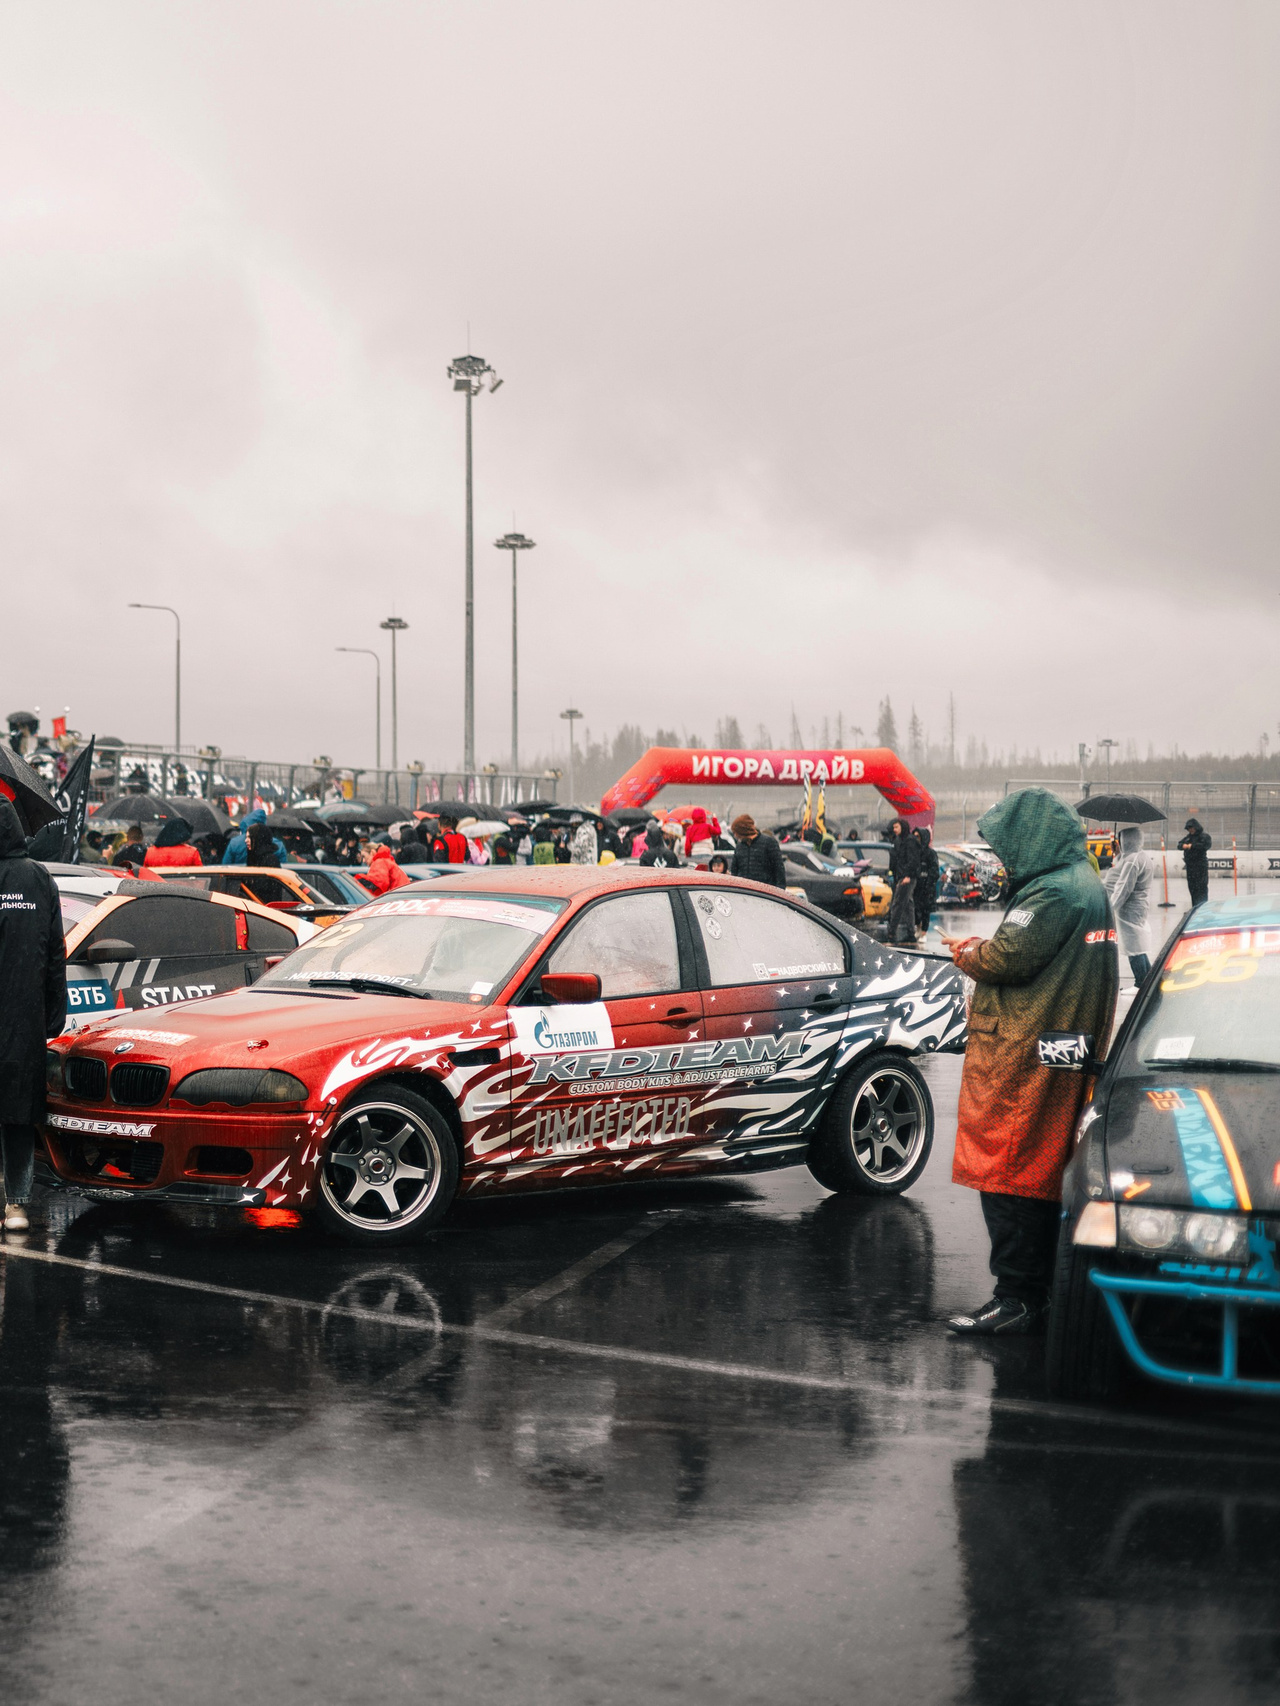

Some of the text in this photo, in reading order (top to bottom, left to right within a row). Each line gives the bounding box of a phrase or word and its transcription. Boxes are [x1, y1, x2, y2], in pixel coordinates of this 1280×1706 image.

[692, 754, 865, 780] ИГОРА ДРАЙВ
[777, 962, 827, 976] НАДВОРСКИЙ
[1161, 947, 1266, 993] 36
[68, 986, 107, 1006] ВТБ
[553, 1029, 598, 1049] ГАЗПРОМ
[524, 1029, 817, 1086] KFDTEAM
[568, 1063, 777, 1096] CUSTOM BODY KITS & ADJUSTABLE ARMS
[46, 1113, 157, 1138] KFDTEAM
[535, 1097, 692, 1155] UNAFFECTED
